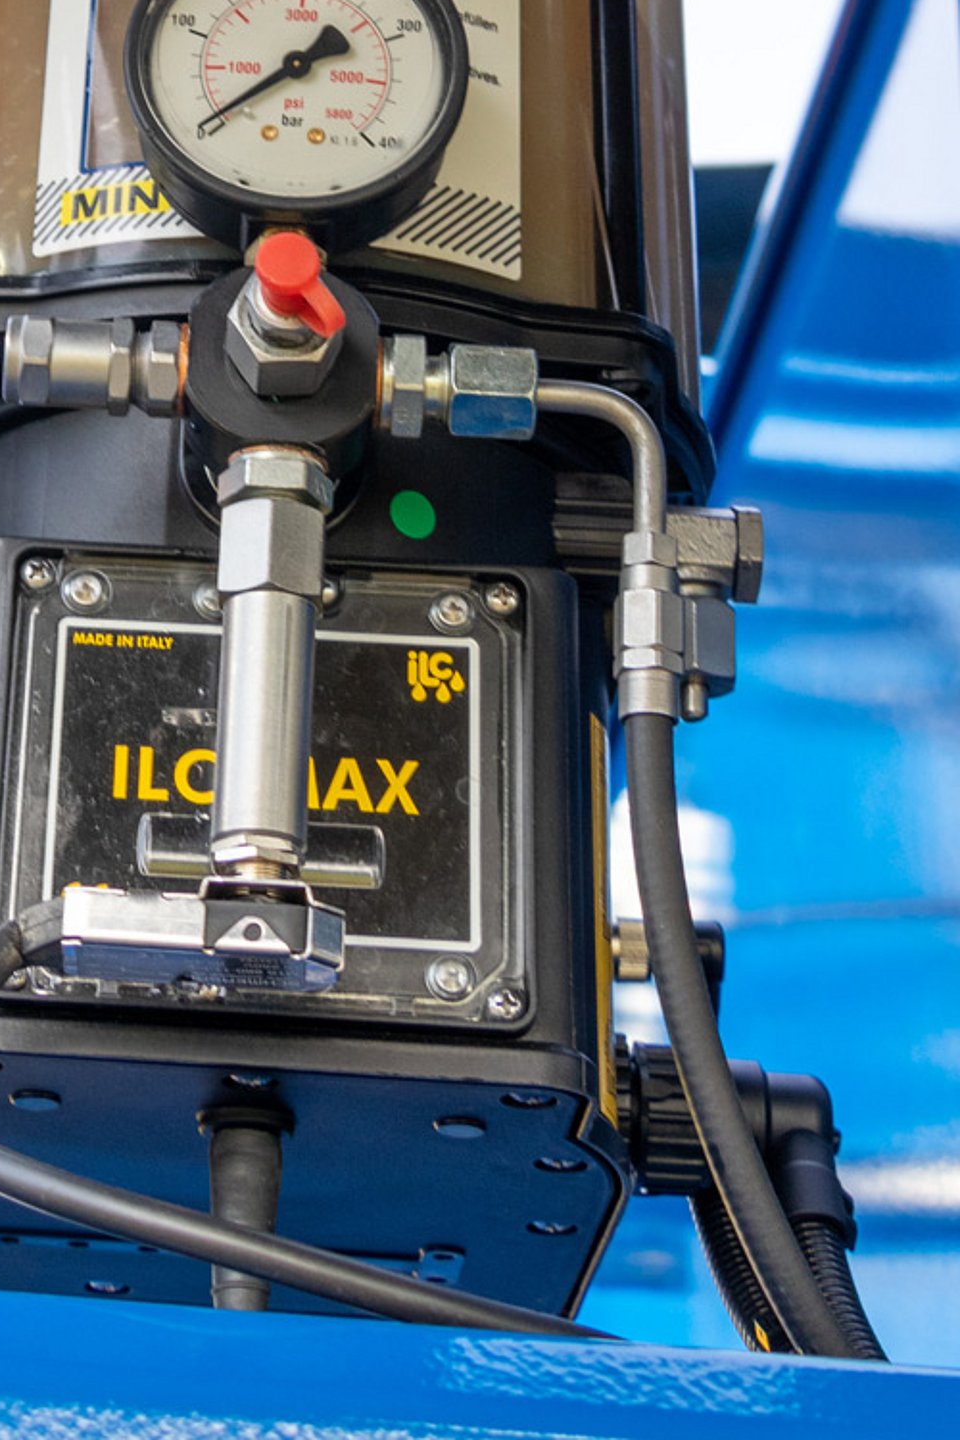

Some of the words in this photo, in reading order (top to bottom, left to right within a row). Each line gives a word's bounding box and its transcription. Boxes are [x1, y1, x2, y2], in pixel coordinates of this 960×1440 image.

[171, 12, 196, 27] 100
[284, 9, 319, 22] 3000
[396, 18, 422, 33] 300
[228, 60, 262, 75] 1000
[329, 70, 365, 84] 5000
[283, 97, 304, 111] psi
[281, 112, 304, 127] bar
[324, 107, 353, 120] 5800
[71, 181, 161, 220] MIN
[72, 631, 114, 647] MADE
[116, 633, 134, 649] IN
[137, 634, 174, 650] ITALY
